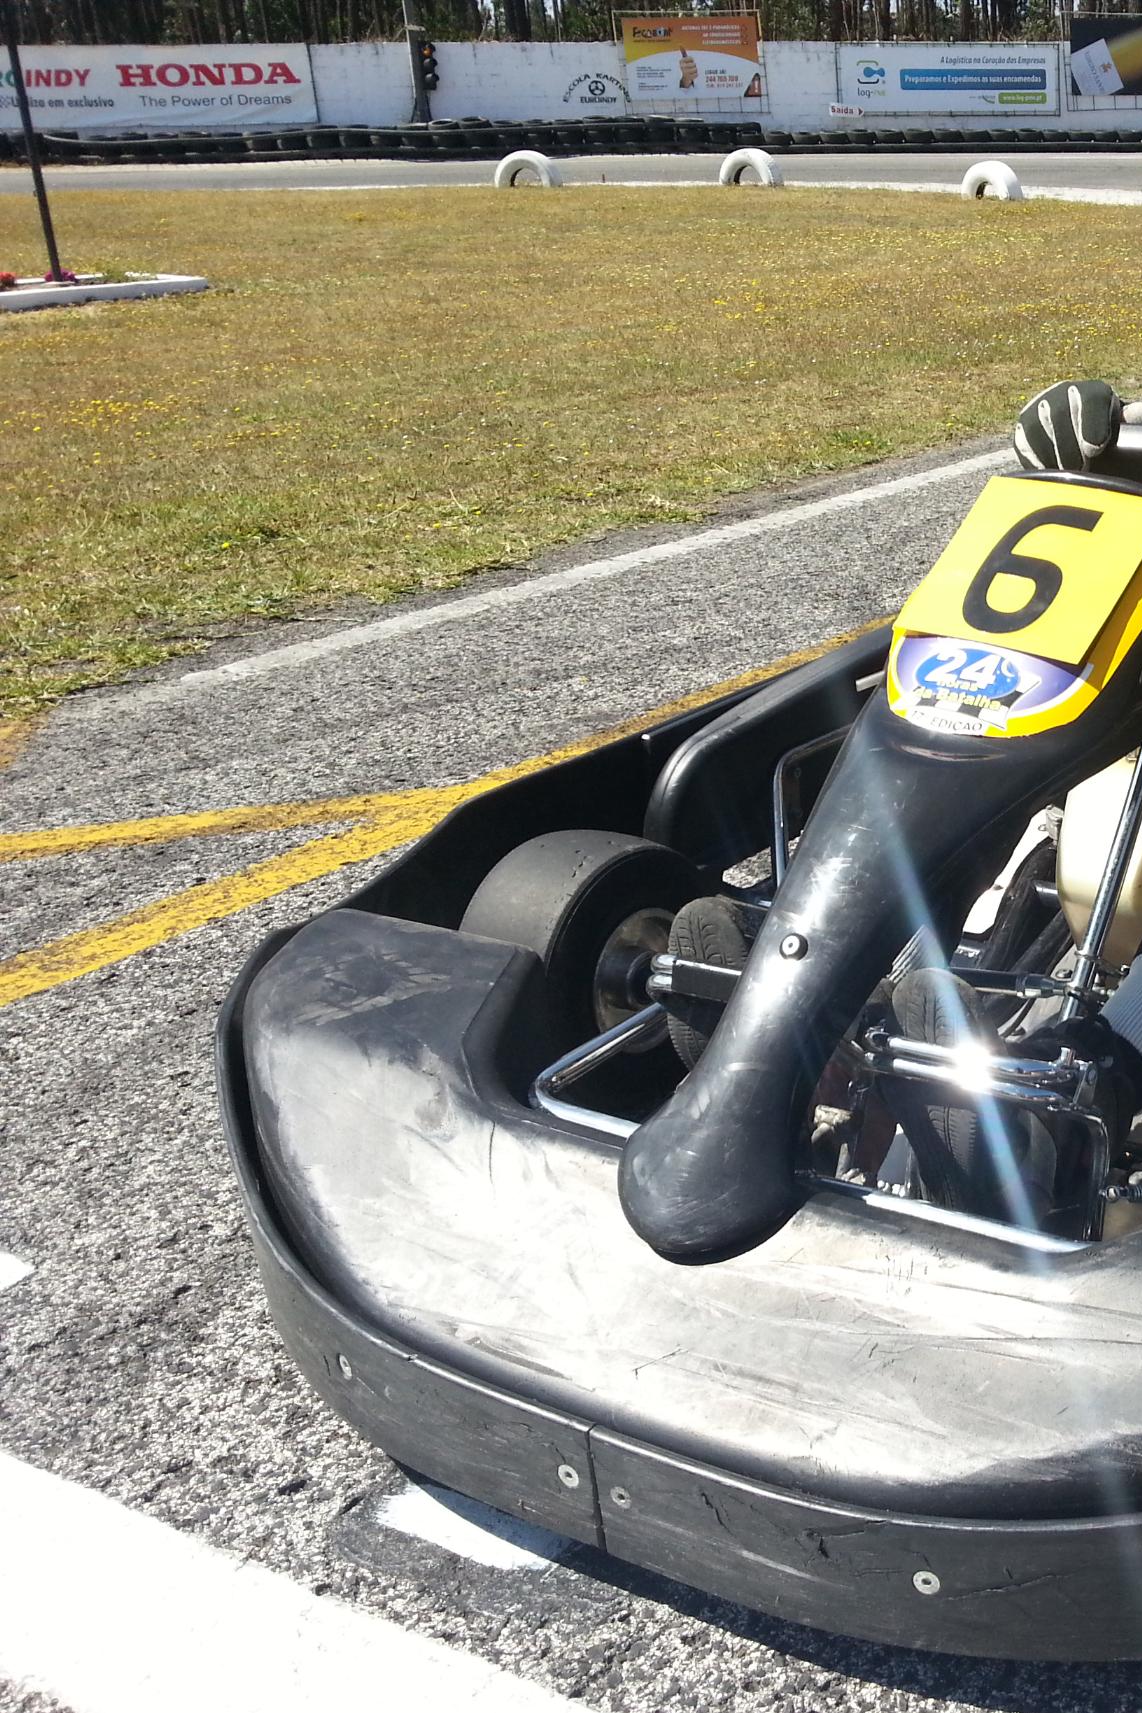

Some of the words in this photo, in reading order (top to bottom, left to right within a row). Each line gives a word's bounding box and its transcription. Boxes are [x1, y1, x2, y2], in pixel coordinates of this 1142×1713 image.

[1017, 56, 1046, 66] Empresas
[115, 62, 302, 87] HONDA
[904, 75, 942, 85] Preparamos
[947, 75, 981, 85] Expedimos
[1003, 75, 1042, 83] encomendas
[48, 99, 65, 107] em
[67, 95, 115, 107] exclusivo
[139, 95, 167, 107] The
[171, 95, 216, 107] Power
[219, 94, 234, 106] of
[237, 93, 292, 106] Dreams
[962, 505, 1104, 634] 6
[923, 644, 1002, 688] 24
